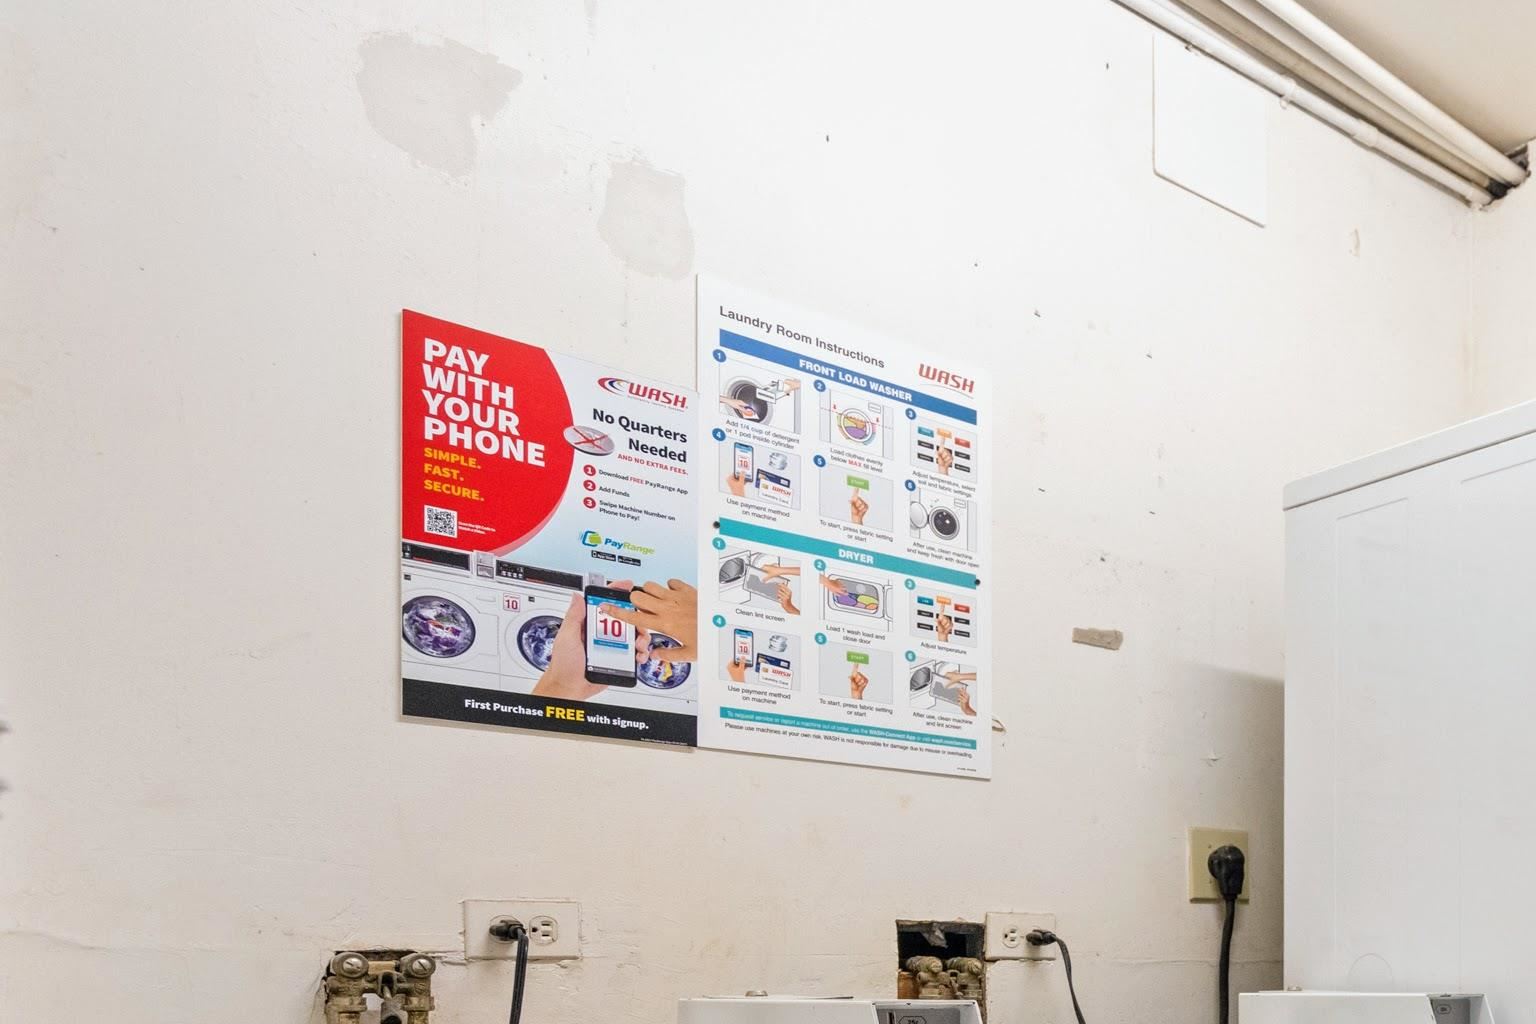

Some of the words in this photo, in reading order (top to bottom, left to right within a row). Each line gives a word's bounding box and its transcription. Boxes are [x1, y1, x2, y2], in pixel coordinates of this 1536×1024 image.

[719, 305, 772, 333] Laundry
[776, 324, 812, 345] Room
[816, 337, 885, 369] Instructions
[424, 337, 490, 374] PAY
[422, 363, 514, 409] WITH
[799, 359, 836, 378] FRONT
[838, 372, 867, 387] LOAD
[869, 381, 913, 402] WASHER
[918, 363, 974, 393] WASH
[628, 382, 687, 409] WASH
[422, 389, 520, 436] YOUR
[593, 408, 615, 424] No
[618, 416, 687, 443] Quarters
[726, 419, 739, 428] Add
[740, 423, 750, 431] 1/4
[424, 416, 545, 467] PHONE
[629, 438, 687, 463] Needed
[424, 447, 481, 469] SIMPLE.
[618, 453, 633, 462] AND
[634, 457, 645, 465] NO
[646, 460, 668, 471] EXTRA
[670, 465, 688, 476] FEES.
[424, 463, 464, 482] FAST.
[599, 469, 629, 481] Download
[629, 476, 644, 485] FREE
[645, 480, 675, 493] PayRange
[677, 487, 688, 496] App
[424, 479, 484, 501] SECURE.
[599, 486, 611, 494] Add
[599, 500, 617, 510] Swipe
[618, 504, 643, 514] Machine
[644, 510, 667, 520] Number
[599, 507, 619, 517] Phone
[627, 513, 640, 521] Pay!
[726, 497, 739, 506] Use
[740, 501, 767, 512] payment
[768, 507, 790, 518] method
[751, 511, 777, 522] machine
[604, 538, 655, 554] PayRange
[838, 549, 874, 564] DRYER
[505, 600, 518, 610] 10
[735, 608, 754, 617] Clean
[754, 612, 764, 620] lint
[765, 614, 785, 622] screen
[600, 618, 622, 637] 10
[728, 685, 740, 693] Use
[741, 688, 767, 697] payment
[769, 692, 791, 700] method
[751, 696, 777, 705] machine
[464, 699, 490, 712] First
[493, 701, 543, 717] Purchase
[545, 706, 585, 722] FREE
[587, 713, 610, 726] with
[612, 718, 649, 730] signup.
